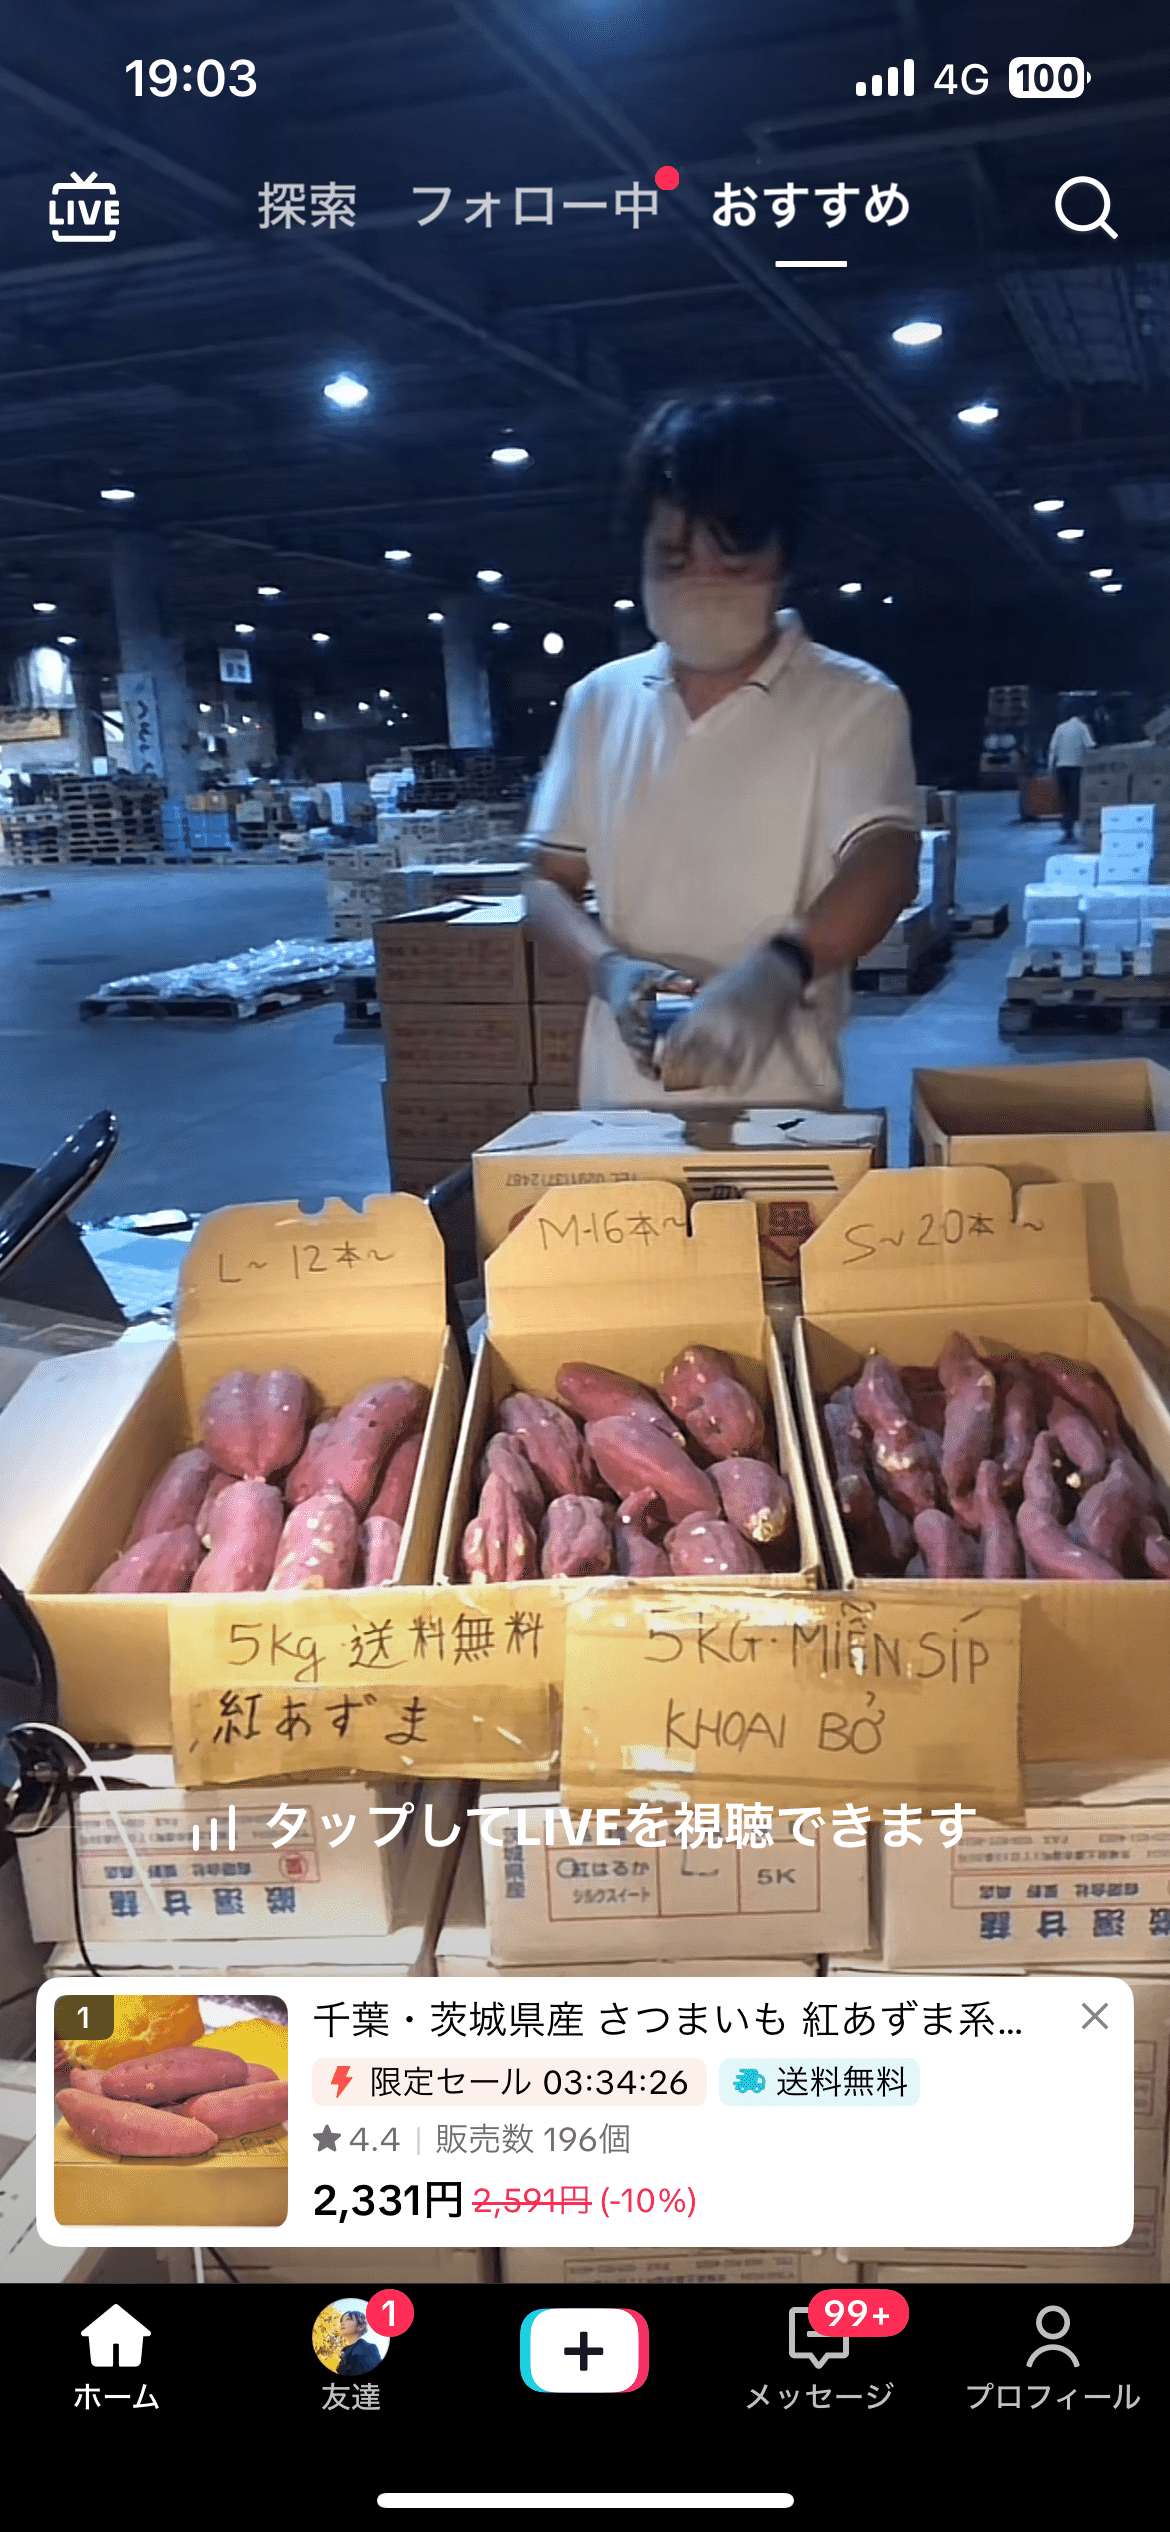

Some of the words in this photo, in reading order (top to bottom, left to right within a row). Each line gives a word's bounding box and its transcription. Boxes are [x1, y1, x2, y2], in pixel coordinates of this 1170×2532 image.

[348, 1611, 543, 1669] 送料無料
[213, 1690, 428, 1745] 紅あずま
[666, 1698, 786, 1753] KHOAI
